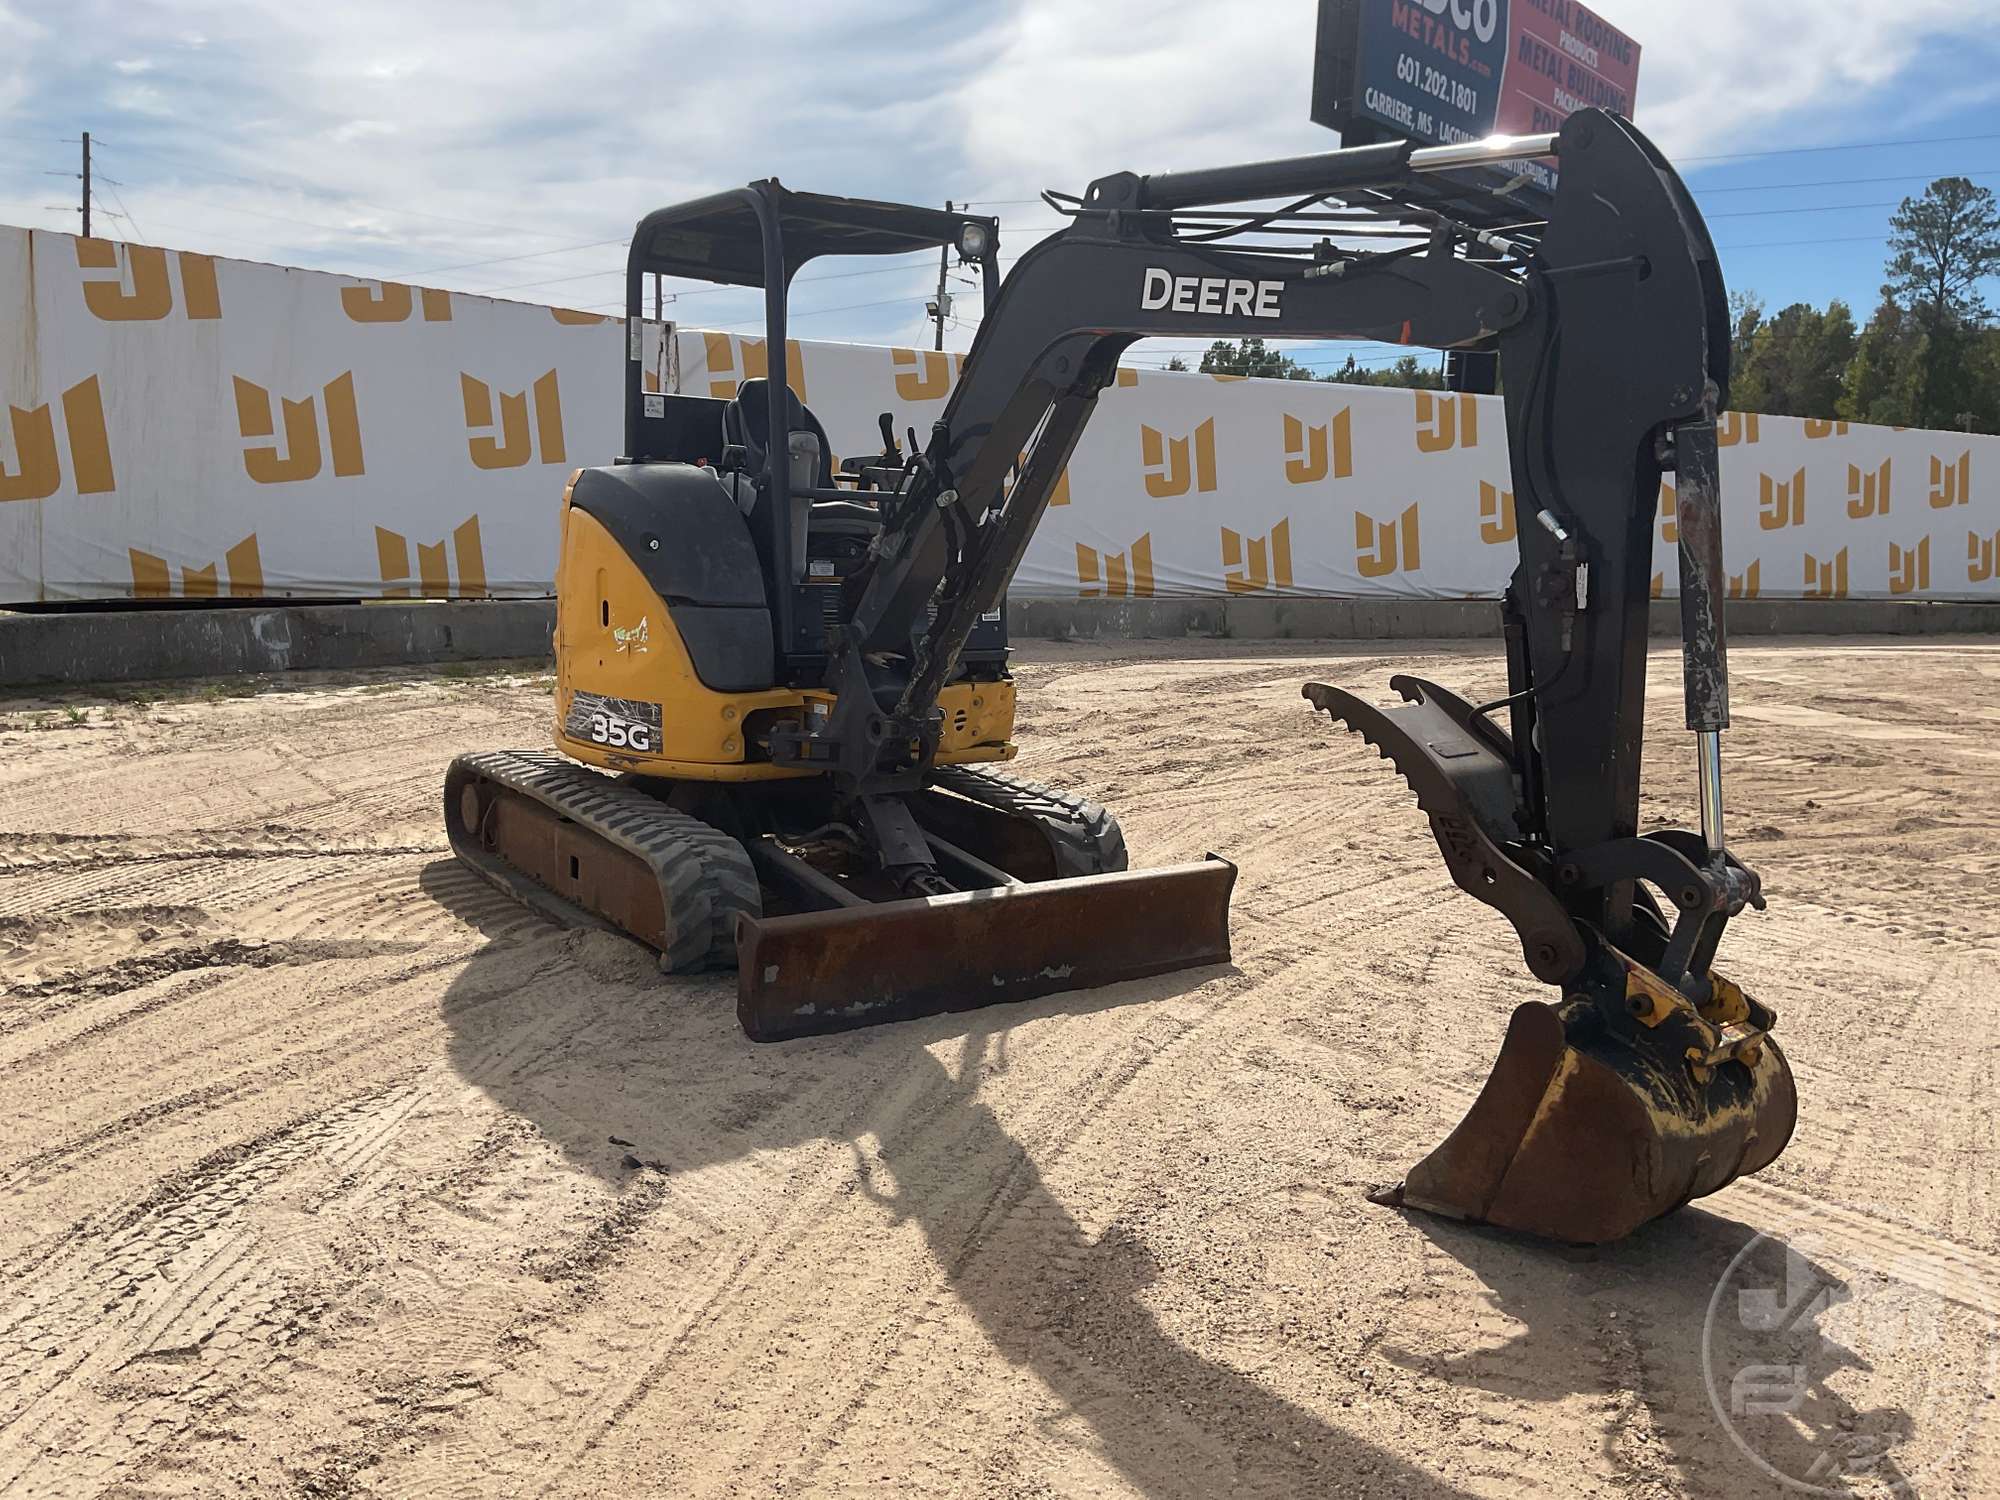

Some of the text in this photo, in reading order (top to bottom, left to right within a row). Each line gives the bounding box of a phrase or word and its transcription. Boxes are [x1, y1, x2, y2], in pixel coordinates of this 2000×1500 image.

[1397, 53, 1477, 115] 601.202.1801
[1365, 87, 1416, 132] CARRIERE,
[1417, 111, 1433, 135] MS
[1141, 267, 1285, 318] DEERE
[591, 714, 649, 750] 35G
